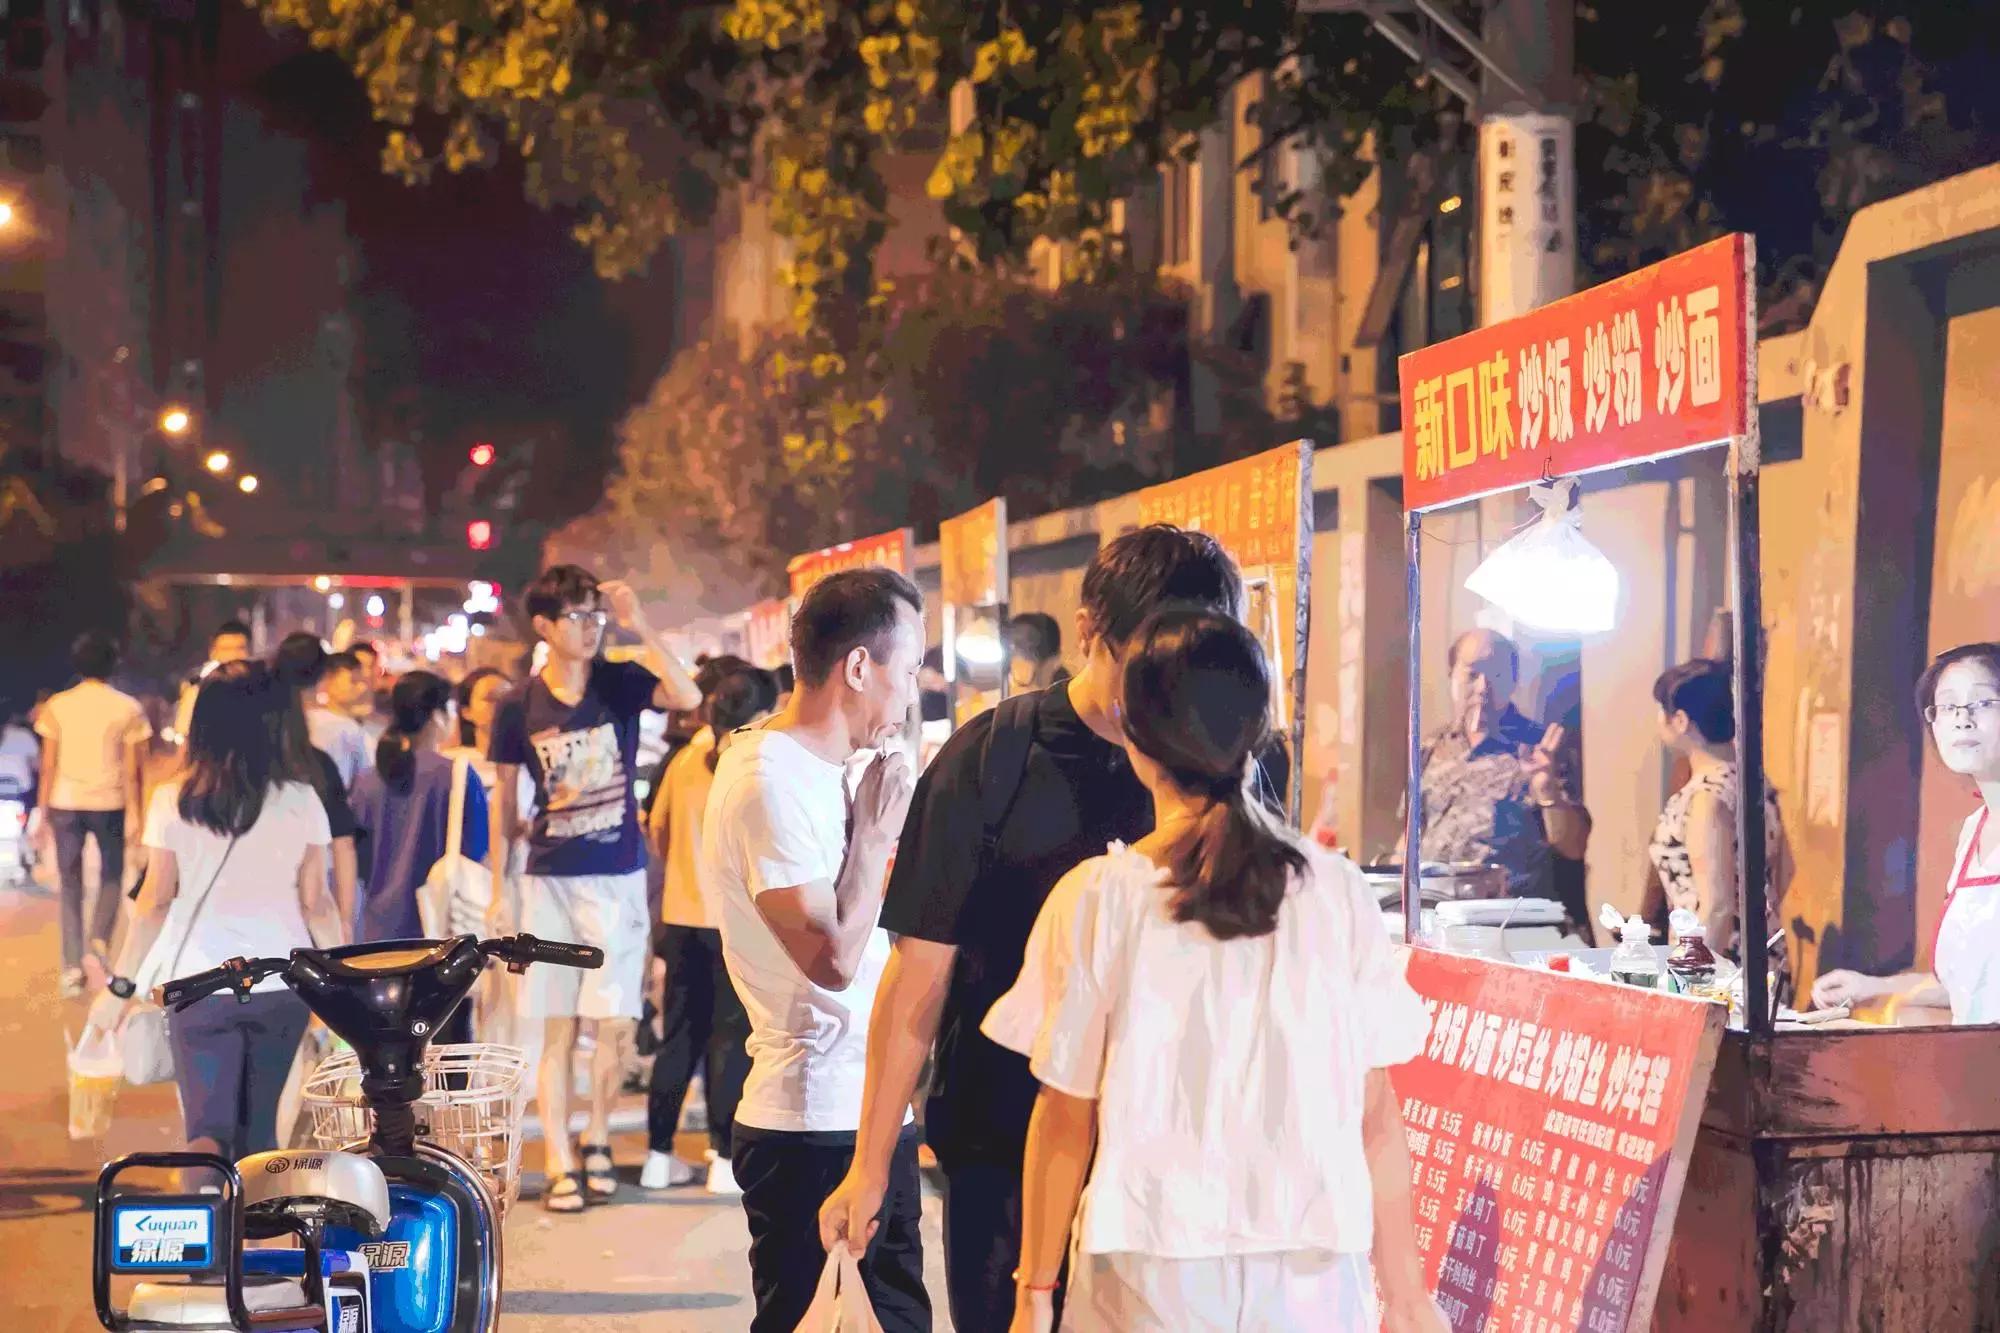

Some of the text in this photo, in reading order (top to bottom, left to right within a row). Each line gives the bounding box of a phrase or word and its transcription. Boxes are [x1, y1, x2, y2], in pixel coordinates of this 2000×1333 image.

[1414, 286, 1720, 481] 新口味 炒饭 炒粉 炒面
[1459, 1010, 1502, 1076] 炒面
[1492, 1017, 1552, 1091] 炒豆丝
[1545, 1028, 1608, 1106] 炒粉丝
[1601, 1043, 1671, 1126] 炒年糕
[1441, 1107, 1463, 1137] 5.5元
[292, 1157, 323, 1170] 绿源
[1433, 1138, 1456, 1166] 5.5元
[1521, 1138, 1546, 1166] 6.0元
[1426, 1167, 1448, 1194] 5.5元
[1511, 1173, 1536, 1202] 6.0元
[1622, 1174, 1649, 1204] 6.0元
[1454, 1188, 1527, 1237] 玉米鸡丁 6.0元
[1614, 1207, 1641, 1237] 6.0元
[130, 1238, 185, 1263] 绿源
[358, 1241, 408, 1268] 绿源
[1446, 1221, 1518, 1272] 香菇鸡丁 6.0元
[1605, 1240, 1633, 1271] 6.0元
[1436, 1255, 1509, 1308] 老干妈肉丝 6.0元
[1597, 1273, 1624, 1305] 6.0元
